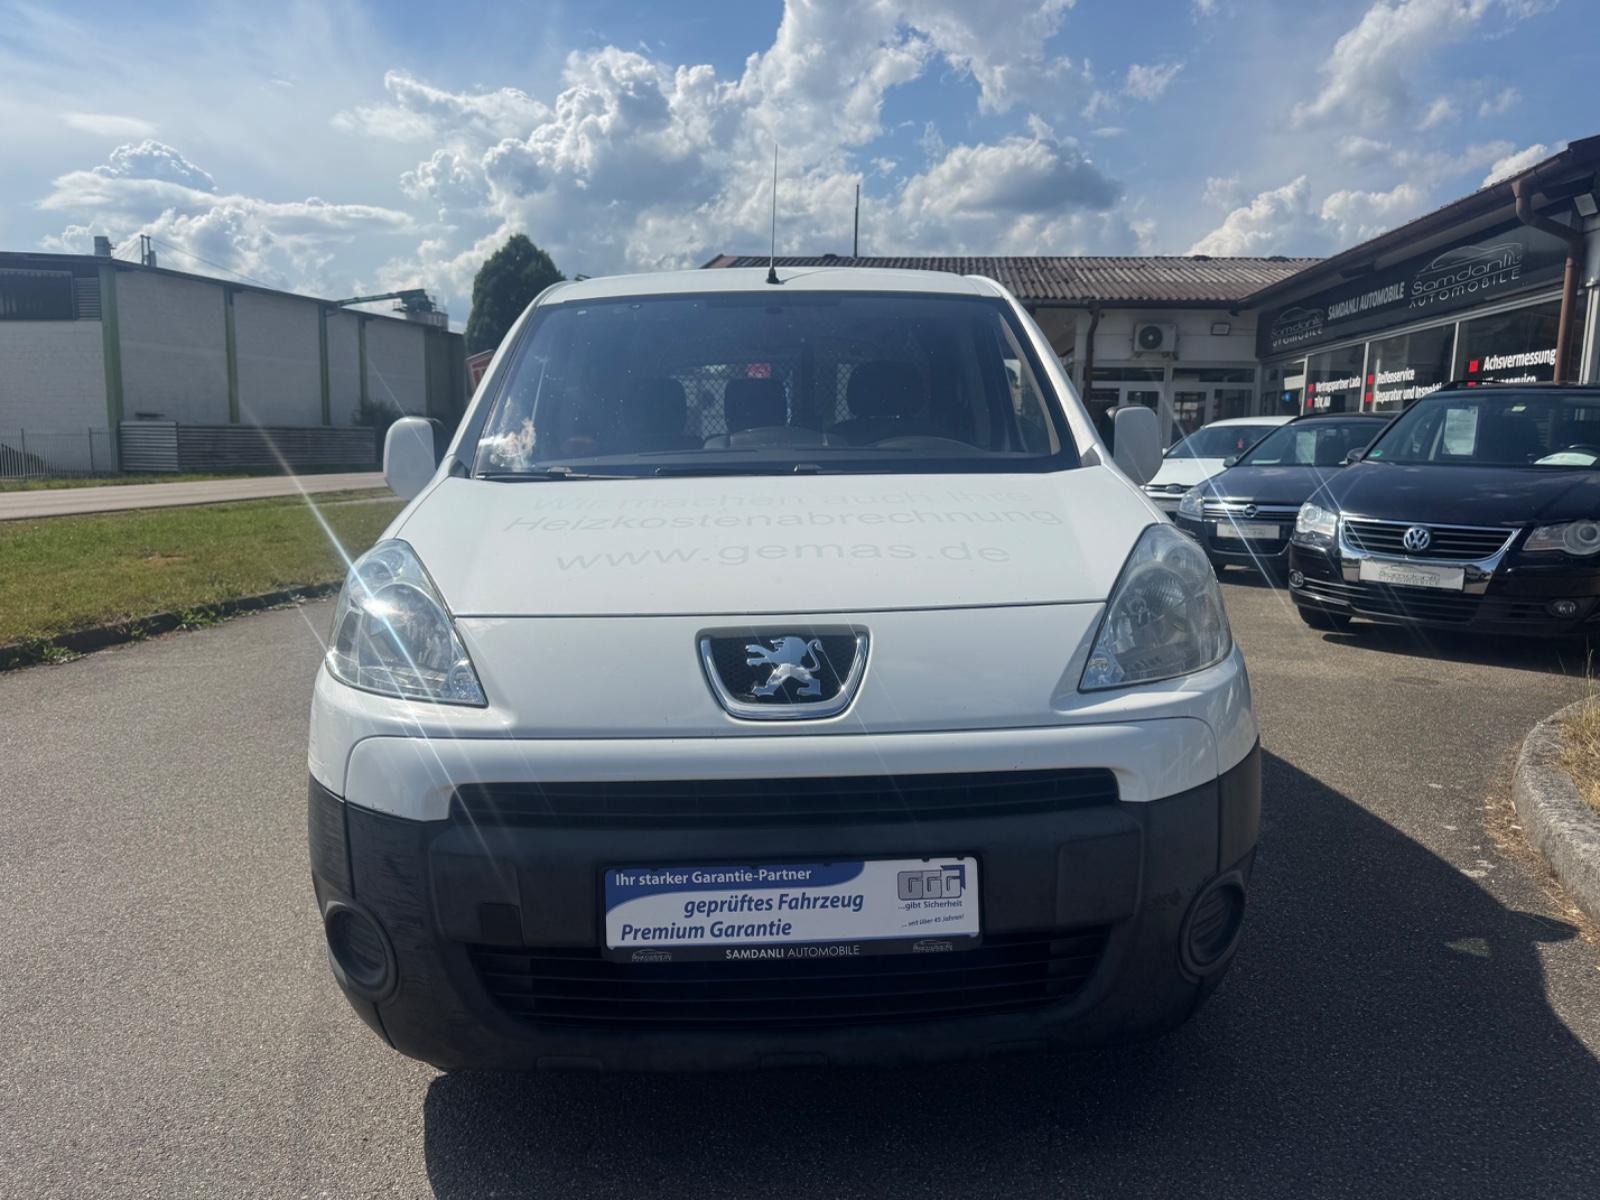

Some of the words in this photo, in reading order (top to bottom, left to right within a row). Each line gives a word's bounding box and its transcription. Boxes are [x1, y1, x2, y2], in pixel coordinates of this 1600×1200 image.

[1327, 296, 1360, 321] SAMDANLI
[1360, 281, 1405, 311] AUTOMOBILE
[1483, 349, 1557, 371] Achsvermessung
[1403, 385, 1415, 400] und
[503, 509, 1065, 533] Heizkostenabrechnung
[556, 541, 1011, 571] www.gemas.de
[615, 874, 636, 886] Ihr
[639, 872, 689, 886] starker
[691, 869, 812, 885] Garantie-Partner
[684, 894, 773, 918] geprüftes
[778, 892, 865, 912] Fahrzeug
[923, 900, 963, 909] Sicherheit
[621, 923, 705, 941] Premium
[709, 920, 792, 938] Garantie
[725, 948, 784, 960] SAMDANLI
[787, 945, 860, 958] AUTOMOBILE
